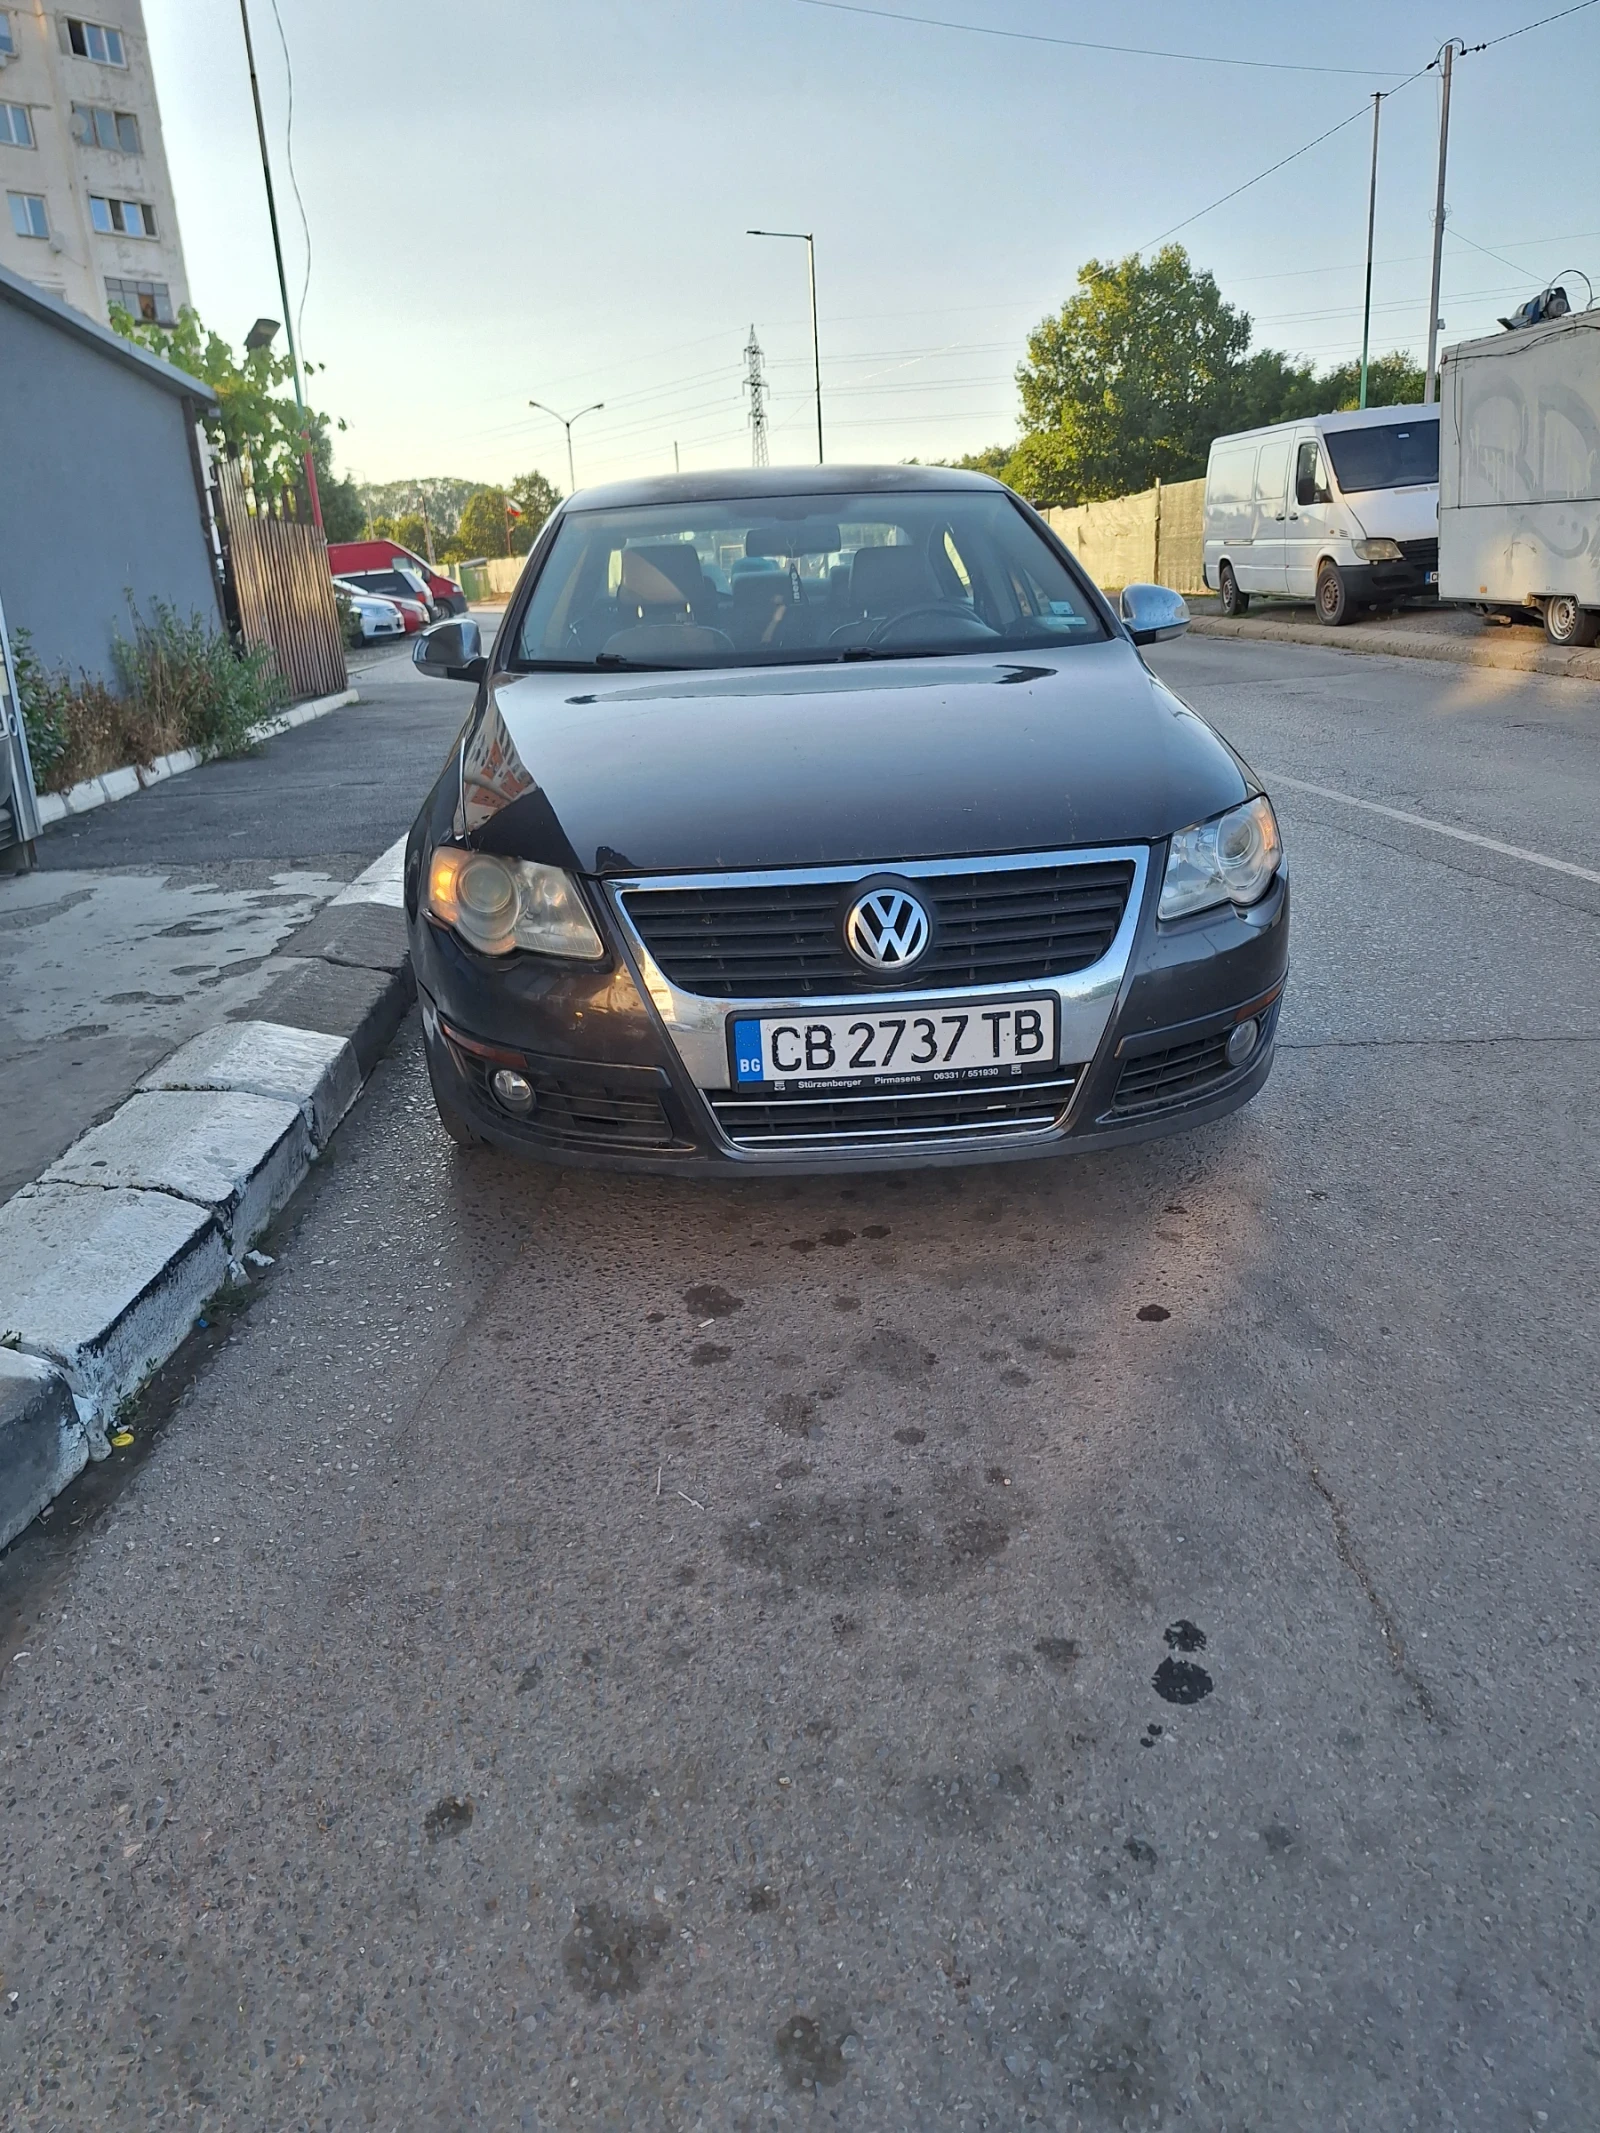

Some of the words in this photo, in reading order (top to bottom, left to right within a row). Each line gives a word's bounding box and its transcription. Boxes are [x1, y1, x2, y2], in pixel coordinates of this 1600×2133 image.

[848, 888, 928, 970] VW
[772, 1024, 836, 1071] CB
[848, 1015, 968, 1068] 2737
[982, 1009, 1044, 1057] TB
[740, 1058, 761, 1073] BG
[798, 1079, 862, 1089] Stürzenberger
[874, 1075, 922, 1085] Pirmasens
[933, 1071, 960, 1081] 06331
[967, 1067, 999, 1078] 551930
